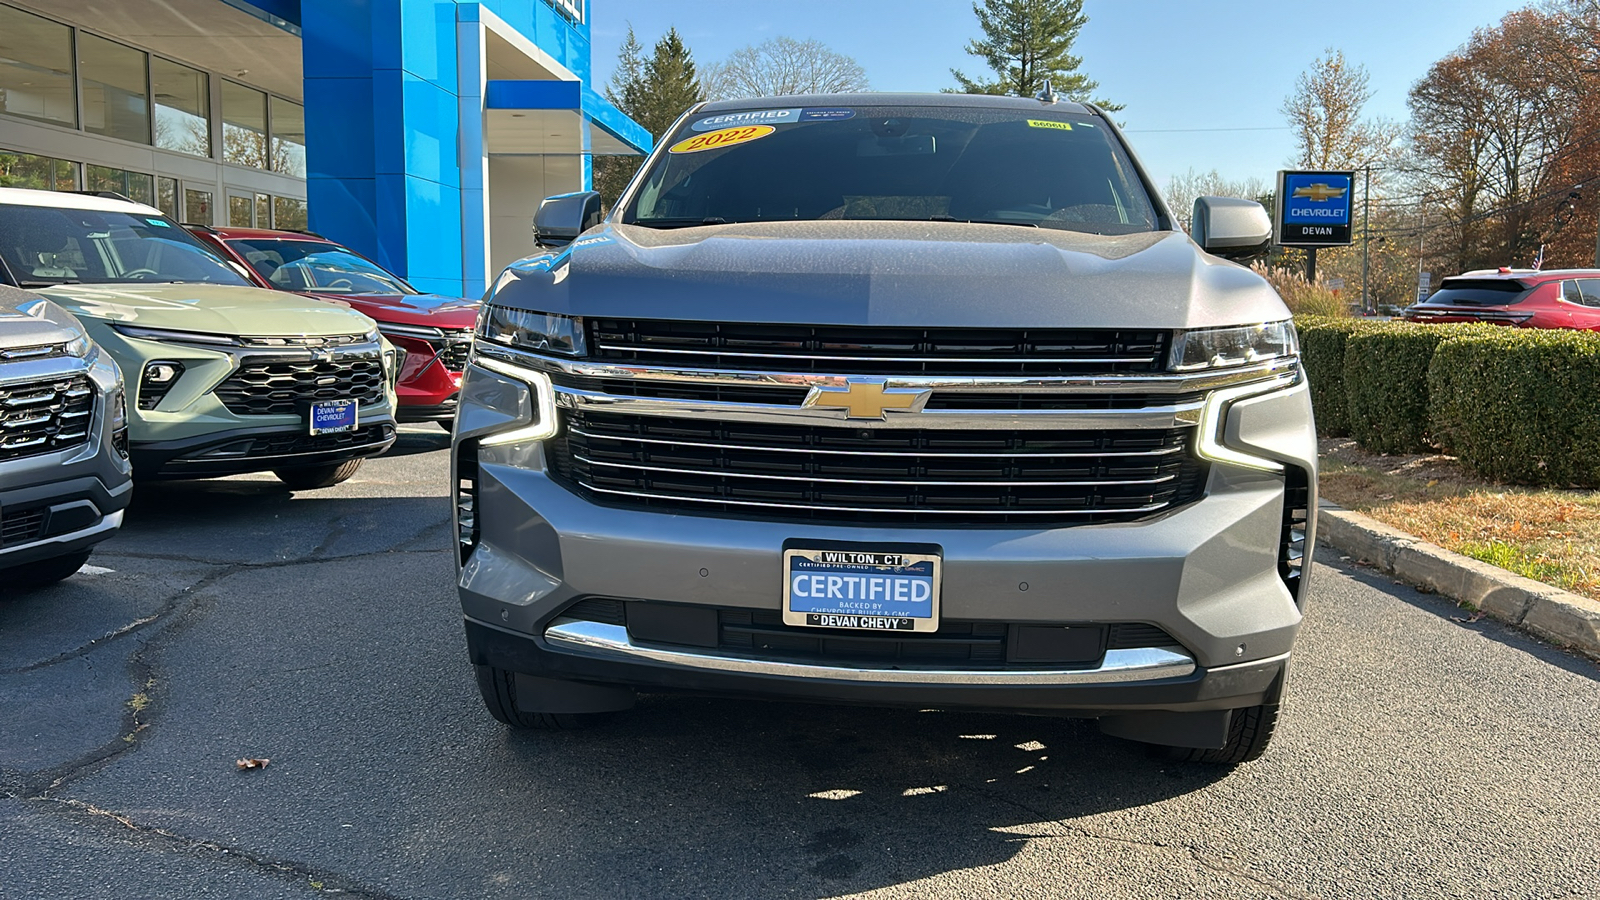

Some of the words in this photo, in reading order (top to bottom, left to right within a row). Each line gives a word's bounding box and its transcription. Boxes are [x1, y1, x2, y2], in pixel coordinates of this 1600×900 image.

[703, 111, 790, 125] CERTIFIED
[686, 127, 757, 151] 2022
[1291, 208, 1345, 217] CHEVROLET
[1302, 226, 1333, 235] DEVAN
[317, 407, 335, 415] DEVAN
[317, 413, 345, 422] CHEVROLET
[825, 552, 879, 565] WILTON,
[884, 555, 900, 565] CT
[792, 574, 931, 602] CERTIFIED
[820, 615, 858, 628] DEVAN
[860, 617, 900, 630] CHEVY
